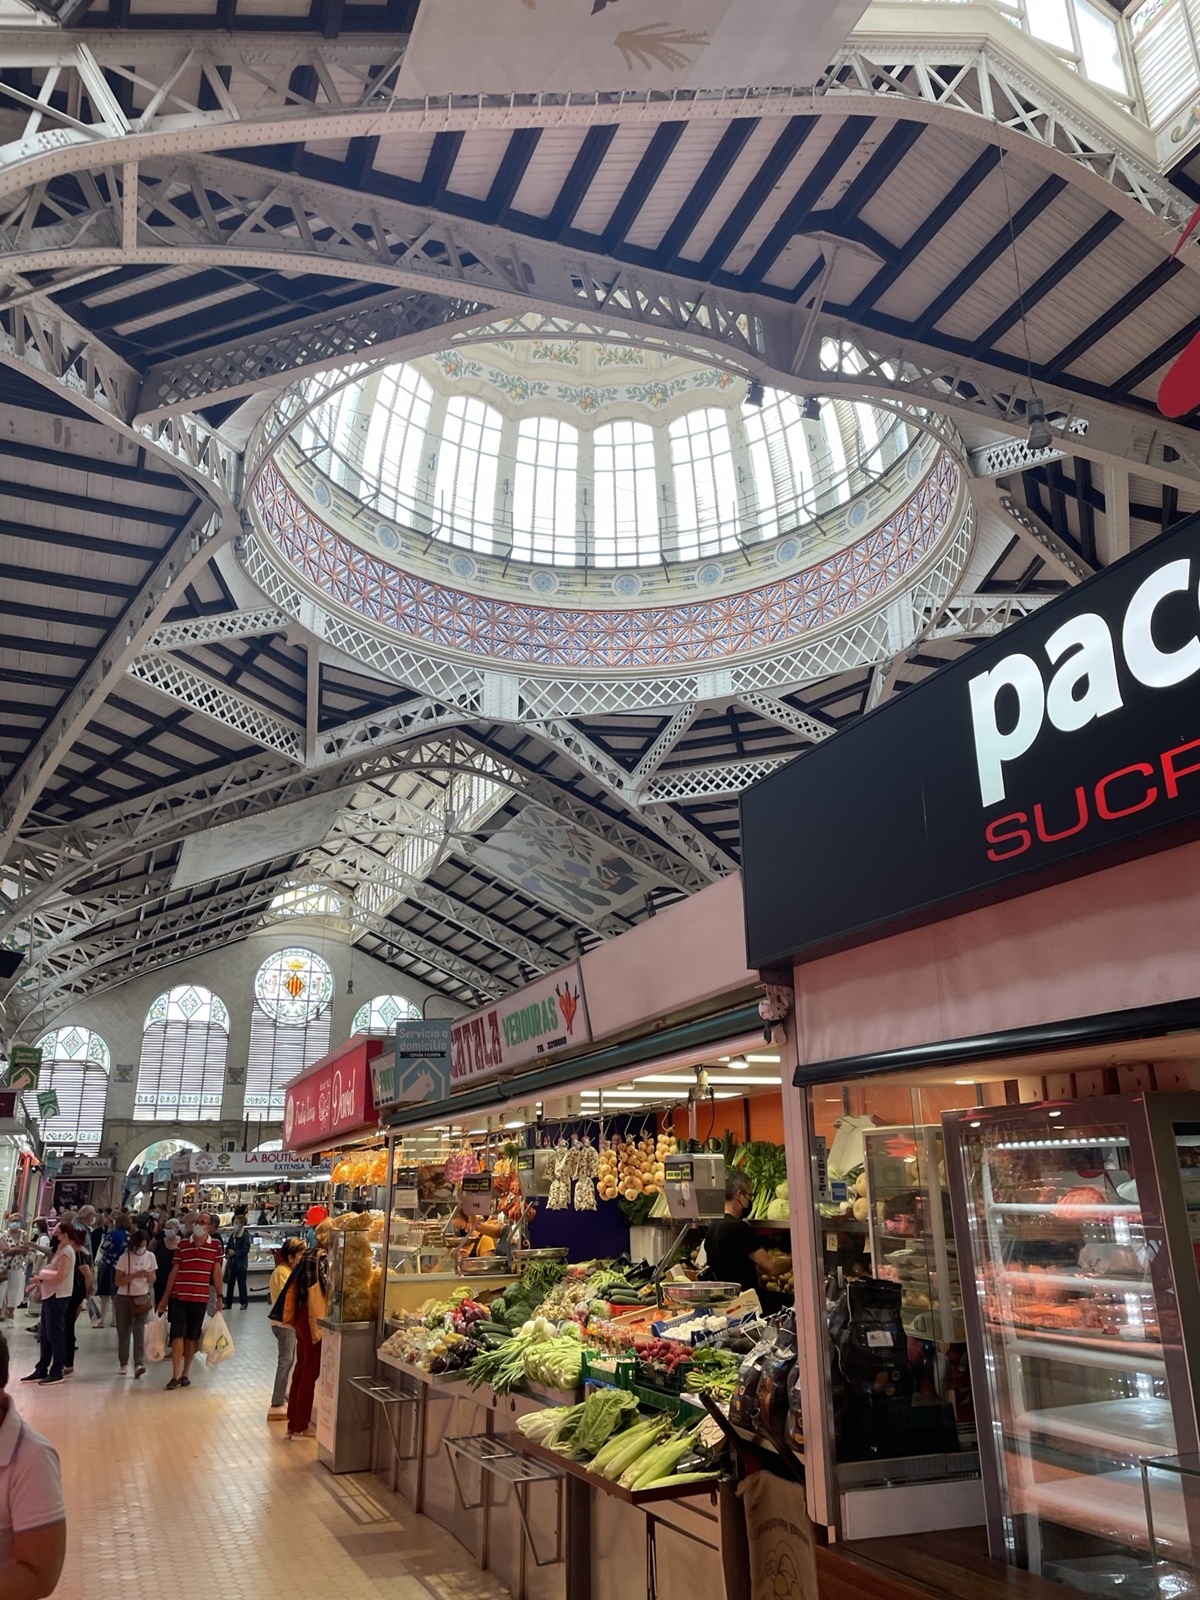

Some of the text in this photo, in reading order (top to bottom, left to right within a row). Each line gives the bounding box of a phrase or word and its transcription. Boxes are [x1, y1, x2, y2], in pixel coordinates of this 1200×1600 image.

[968, 559, 1200, 808] pac
[502, 996, 559, 1048] VERDURAS
[399, 1027, 448, 1039] Servicio a
[400, 1040, 447, 1051] domicilio
[245, 1153, 258, 1163] LA
[274, 1163, 306, 1171] EXTENSA
